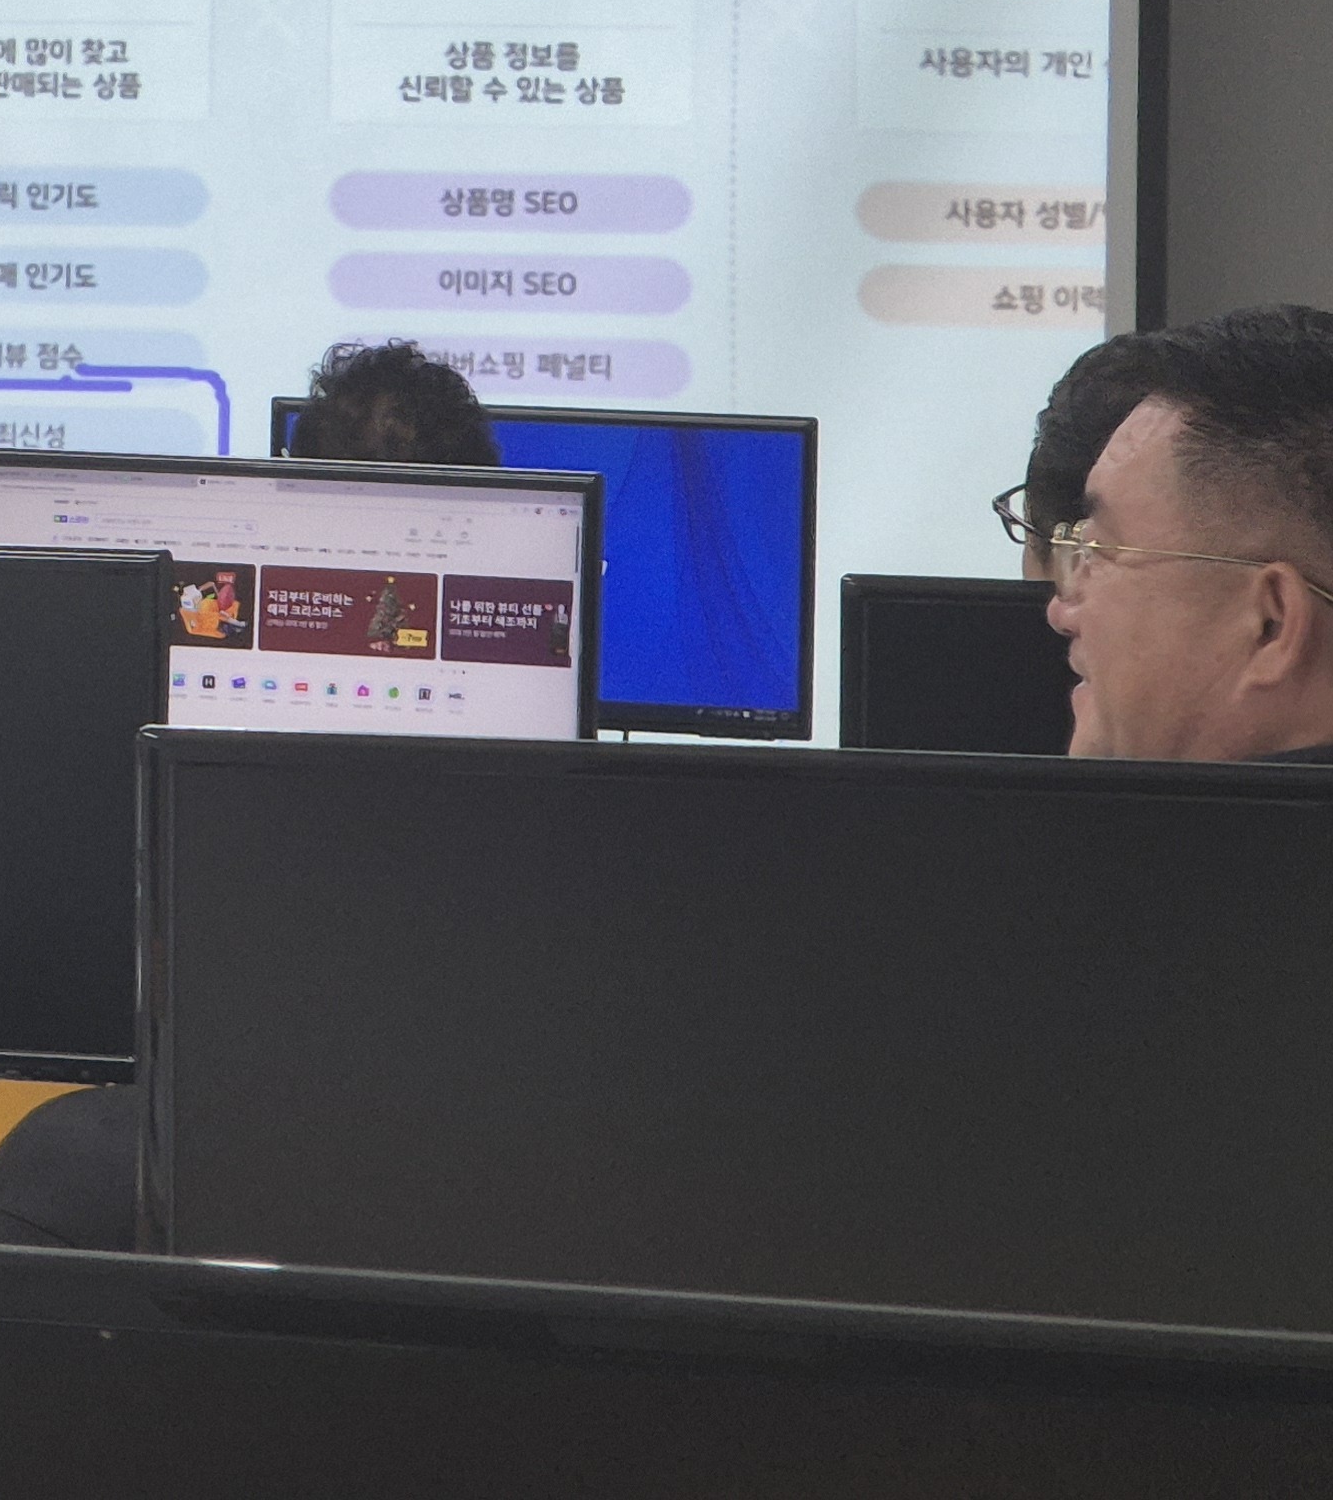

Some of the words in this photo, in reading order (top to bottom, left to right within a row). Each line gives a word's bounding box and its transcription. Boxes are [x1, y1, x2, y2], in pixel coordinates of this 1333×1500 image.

[25, 38, 72, 66] 많이
[81, 38, 129, 64] 찾고
[445, 41, 496, 71] 상품
[504, 41, 581, 71] 정보를
[920, 47, 1030, 77] 사용자의
[1042, 50, 1093, 79] 개인
[92, 72, 141, 100] 상품
[398, 75, 473, 103] 신뢰할
[483, 76, 508, 101] 수
[517, 76, 566, 104] 있는
[574, 77, 626, 105] 상품
[25, 182, 100, 210] 인기도
[440, 188, 514, 217] 상품명
[524, 190, 579, 215] SEO
[945, 199, 1025, 228] 사용자
[1036, 201, 1107, 230] 성별/
[25, 263, 99, 289] 인기도
[438, 269, 513, 297] 이미지
[523, 272, 577, 296] SEO
[992, 285, 1043, 314] 쇼핑
[37, 344, 83, 370] 점수
